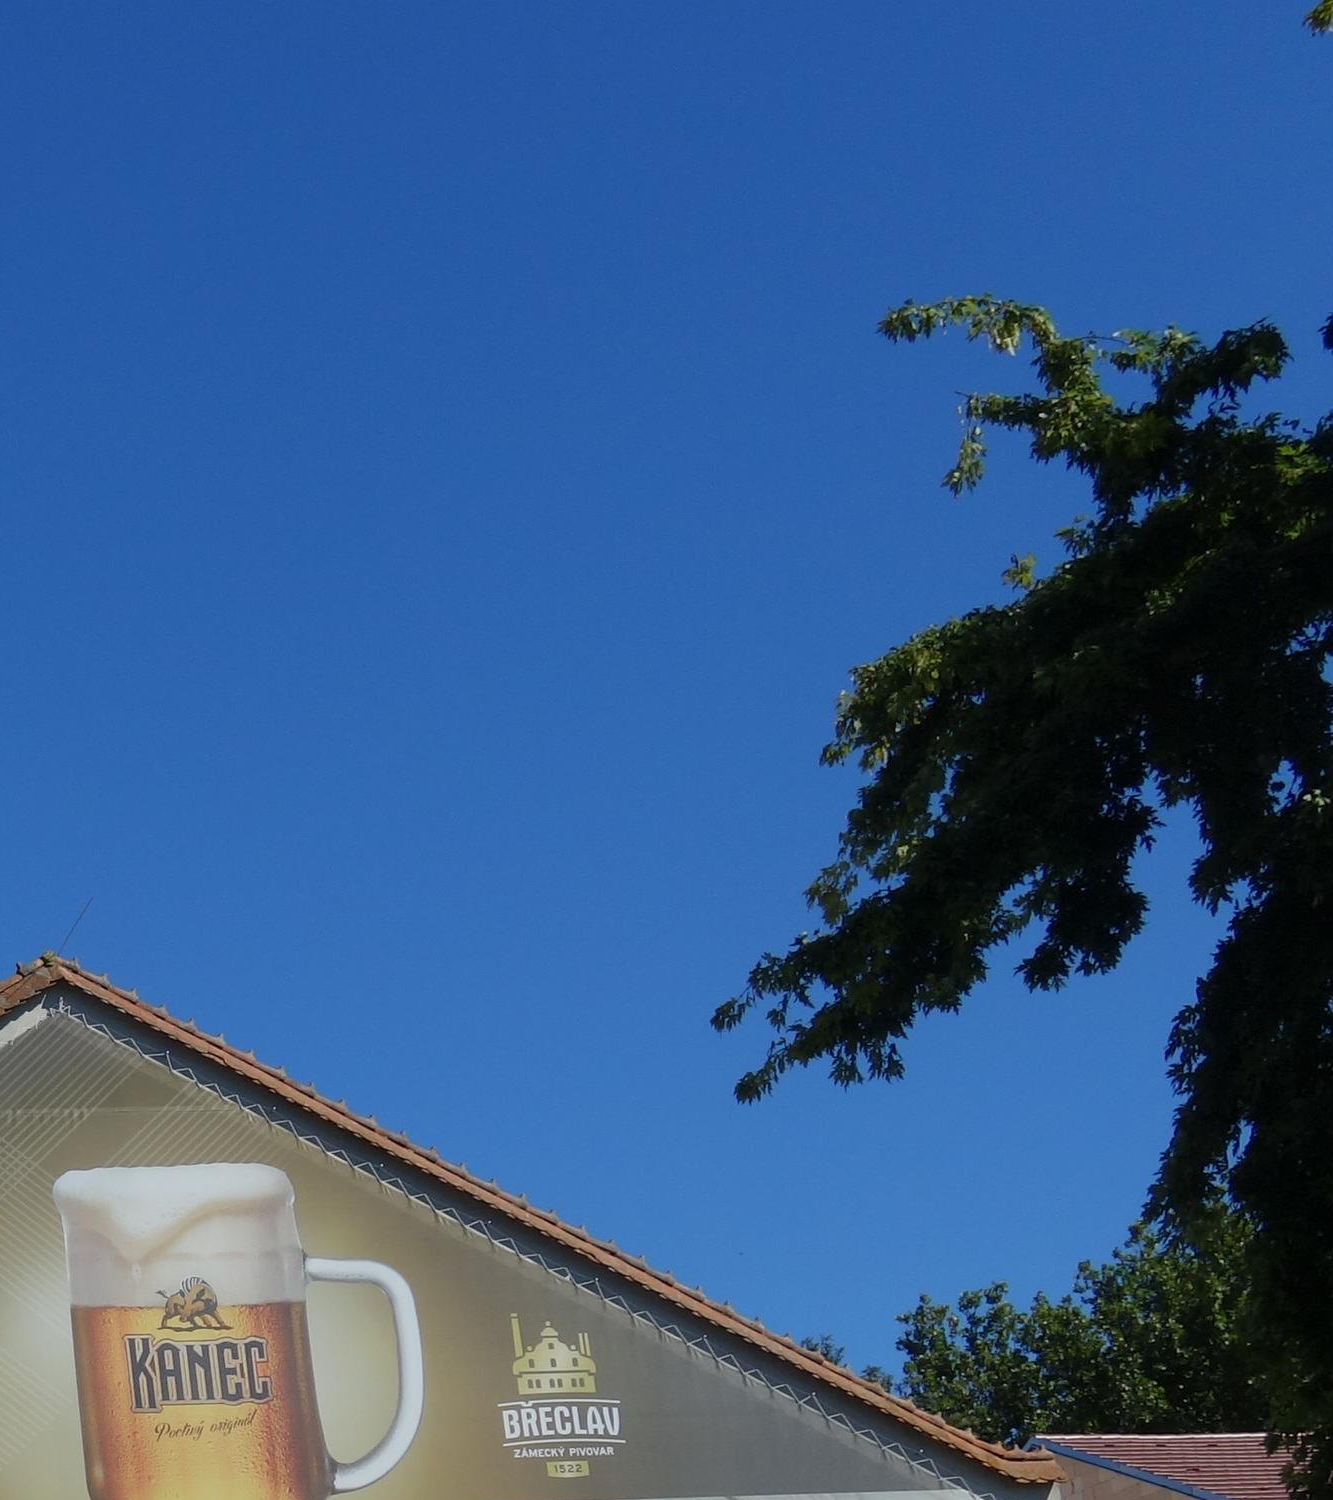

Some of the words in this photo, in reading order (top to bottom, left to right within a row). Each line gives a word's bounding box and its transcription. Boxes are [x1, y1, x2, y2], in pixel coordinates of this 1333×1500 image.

[124, 1333, 273, 1413] KANEC
[155, 1421, 204, 1442] Poctivý
[210, 1409, 257, 1436] originál
[502, 1401, 620, 1439] BŘECLAV
[513, 1446, 565, 1458] ZÁMECKÝ
[569, 1446, 615, 1457] PIVOVAR
[554, 1463, 583, 1473] 1522
